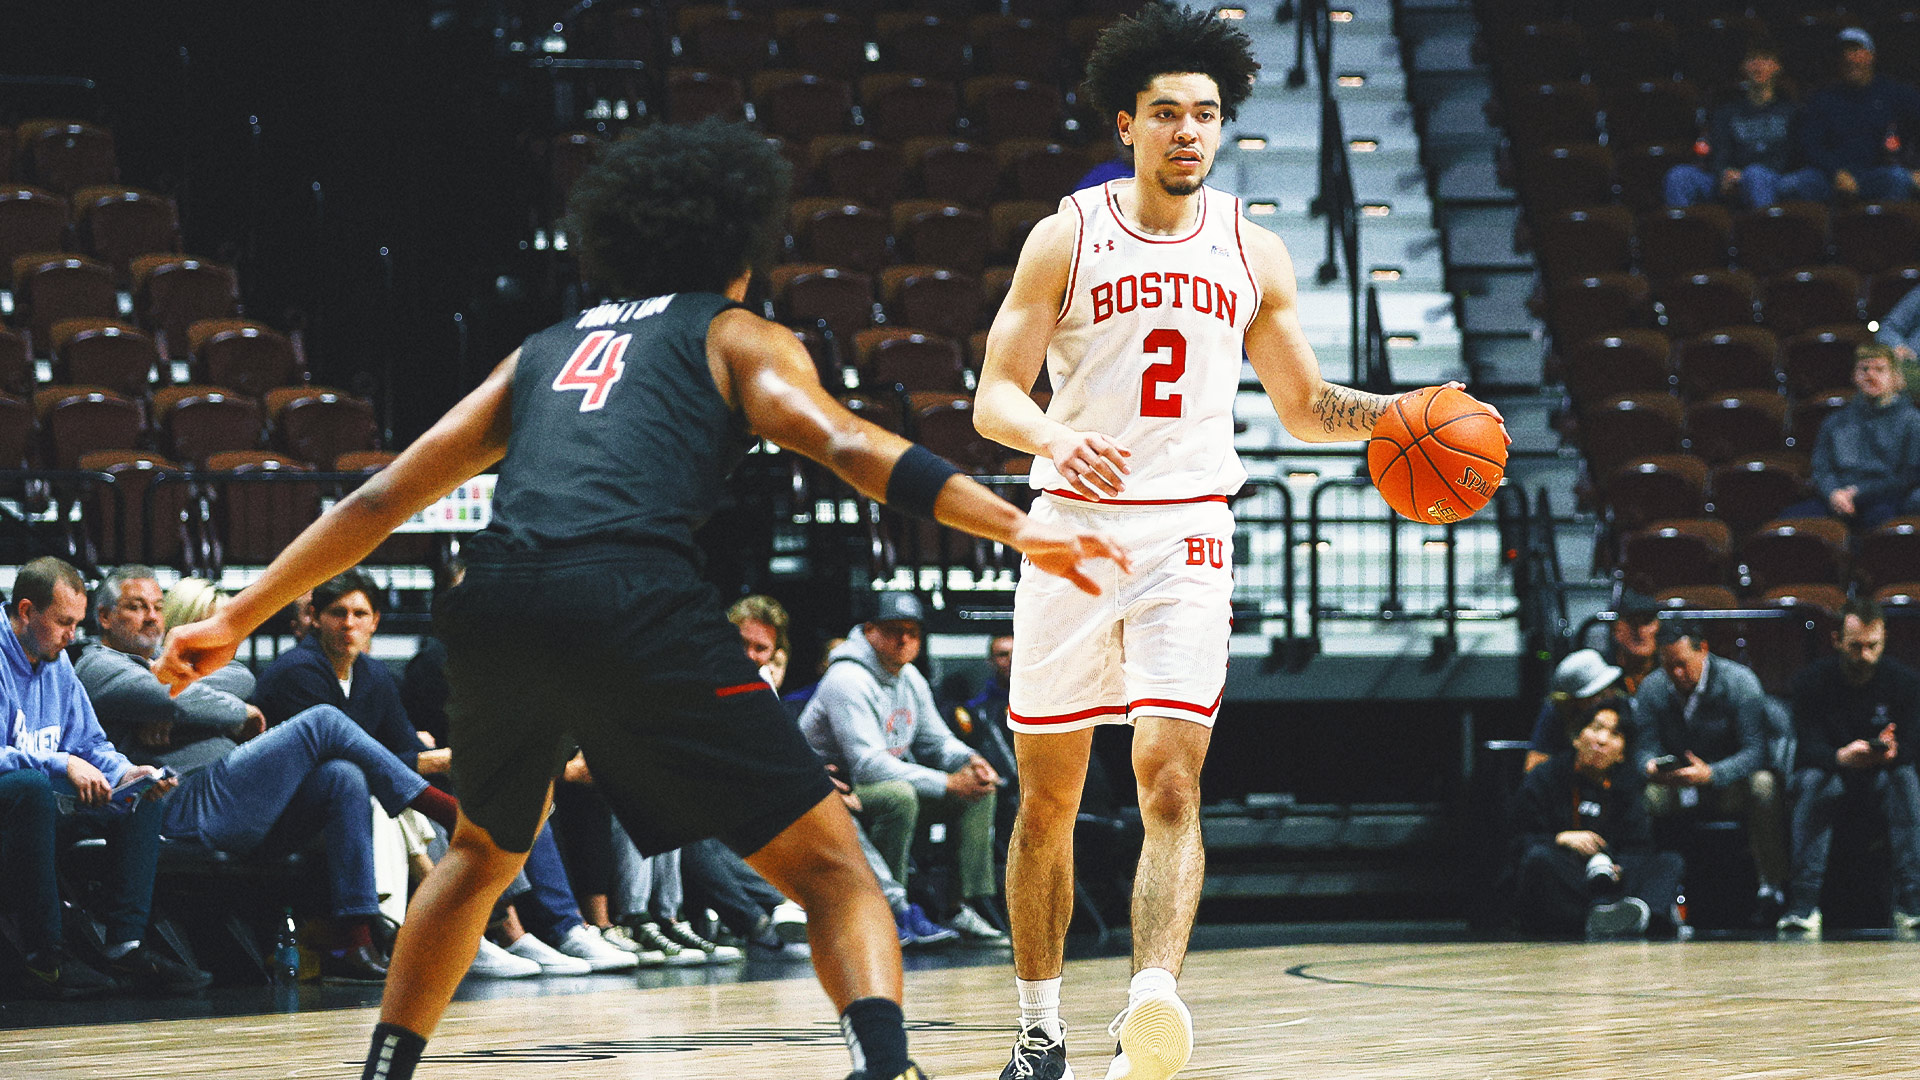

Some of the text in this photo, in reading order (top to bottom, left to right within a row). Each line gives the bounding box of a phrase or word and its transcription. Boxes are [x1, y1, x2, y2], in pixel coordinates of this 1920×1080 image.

[1091, 272, 1237, 328] BOSTON
[552, 330, 632, 413] 4
[1140, 328, 1187, 418] 2
[1184, 538, 1223, 569] BU
